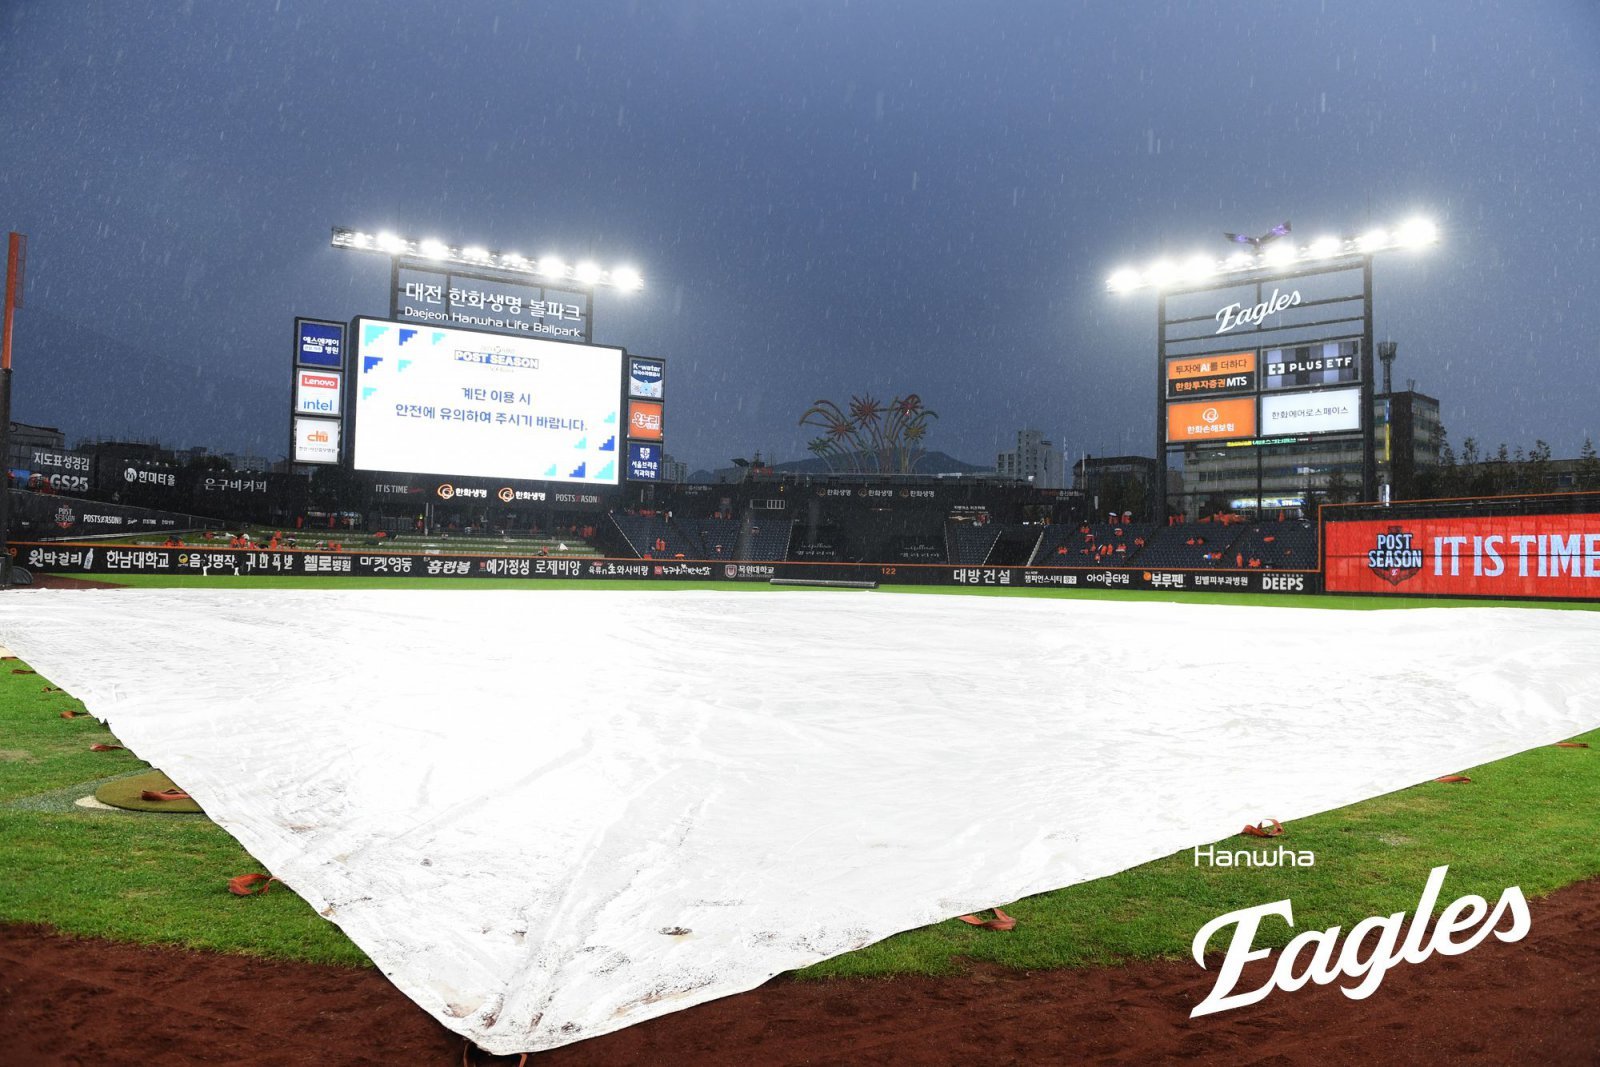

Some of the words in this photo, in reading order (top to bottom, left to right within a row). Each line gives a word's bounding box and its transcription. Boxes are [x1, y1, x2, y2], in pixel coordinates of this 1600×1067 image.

[405, 283, 442, 304] 대전
[449, 288, 522, 314] 한화생명
[529, 299, 582, 321] 볼파크
[1216, 288, 1301, 334] Eagles
[404, 306, 449, 321] Daejeon
[452, 313, 504, 328] Hanwha
[506, 319, 529, 331] Life
[533, 323, 581, 338] Ballpark
[325, 346, 339, 354] 병원
[456, 350, 488, 363] POST
[490, 354, 538, 369] SEASON
[1221, 359, 1247, 369] 더하다
[1289, 360, 1323, 372] PLUS
[1326, 356, 1352, 368] ETF
[633, 363, 661, 372] K-water
[304, 377, 335, 387] Lenovo
[1175, 379, 1225, 391] 한화투자증권
[1226, 376, 1247, 387] MTS
[461, 387, 487, 401] 계단
[490, 390, 515, 404] 이용
[518, 392, 531, 405] 시
[303, 399, 333, 411] intel
[395, 403, 436, 419] 안전에
[439, 407, 492, 424] 유의하여
[495, 412, 532, 427] 주시기
[536, 416, 588, 431] 바랍니다.
[1272, 406, 1349, 420] 한화에어로스페이스
[1187, 423, 1235, 434] 한화손해보험
[34, 452, 90, 471] 지도표성경김
[633, 469, 656, 478] 치과의원
[50, 474, 89, 492] GS25
[203, 478, 267, 493] 은구비커피
[375, 484, 382, 493] IT
[383, 484, 391, 493] IS
[391, 485, 408, 494] TIME
[455, 487, 488, 498] 한화생명
[516, 490, 546, 501] 한화생명
[1377, 534, 1413, 550] POST
[28, 548, 82, 568] 원막걸리
[106, 550, 169, 569] 한남대학교
[1368, 550, 1422, 568] SEASON
[1434, 536, 1467, 576] IT
[1473, 535, 1505, 577] IS
[1510, 534, 1600, 578] TIME
[360, 556, 412, 572] 마켓영동
[427, 560, 471, 574] 홈런볼
[486, 558, 530, 575] 예가정성
[535, 560, 581, 576] 로제비앙
[738, 565, 775, 574] 목원대학교
[881, 567, 896, 575] 122
[953, 569, 1010, 584] 대방건설
[1262, 577, 1304, 591] DEEPS
